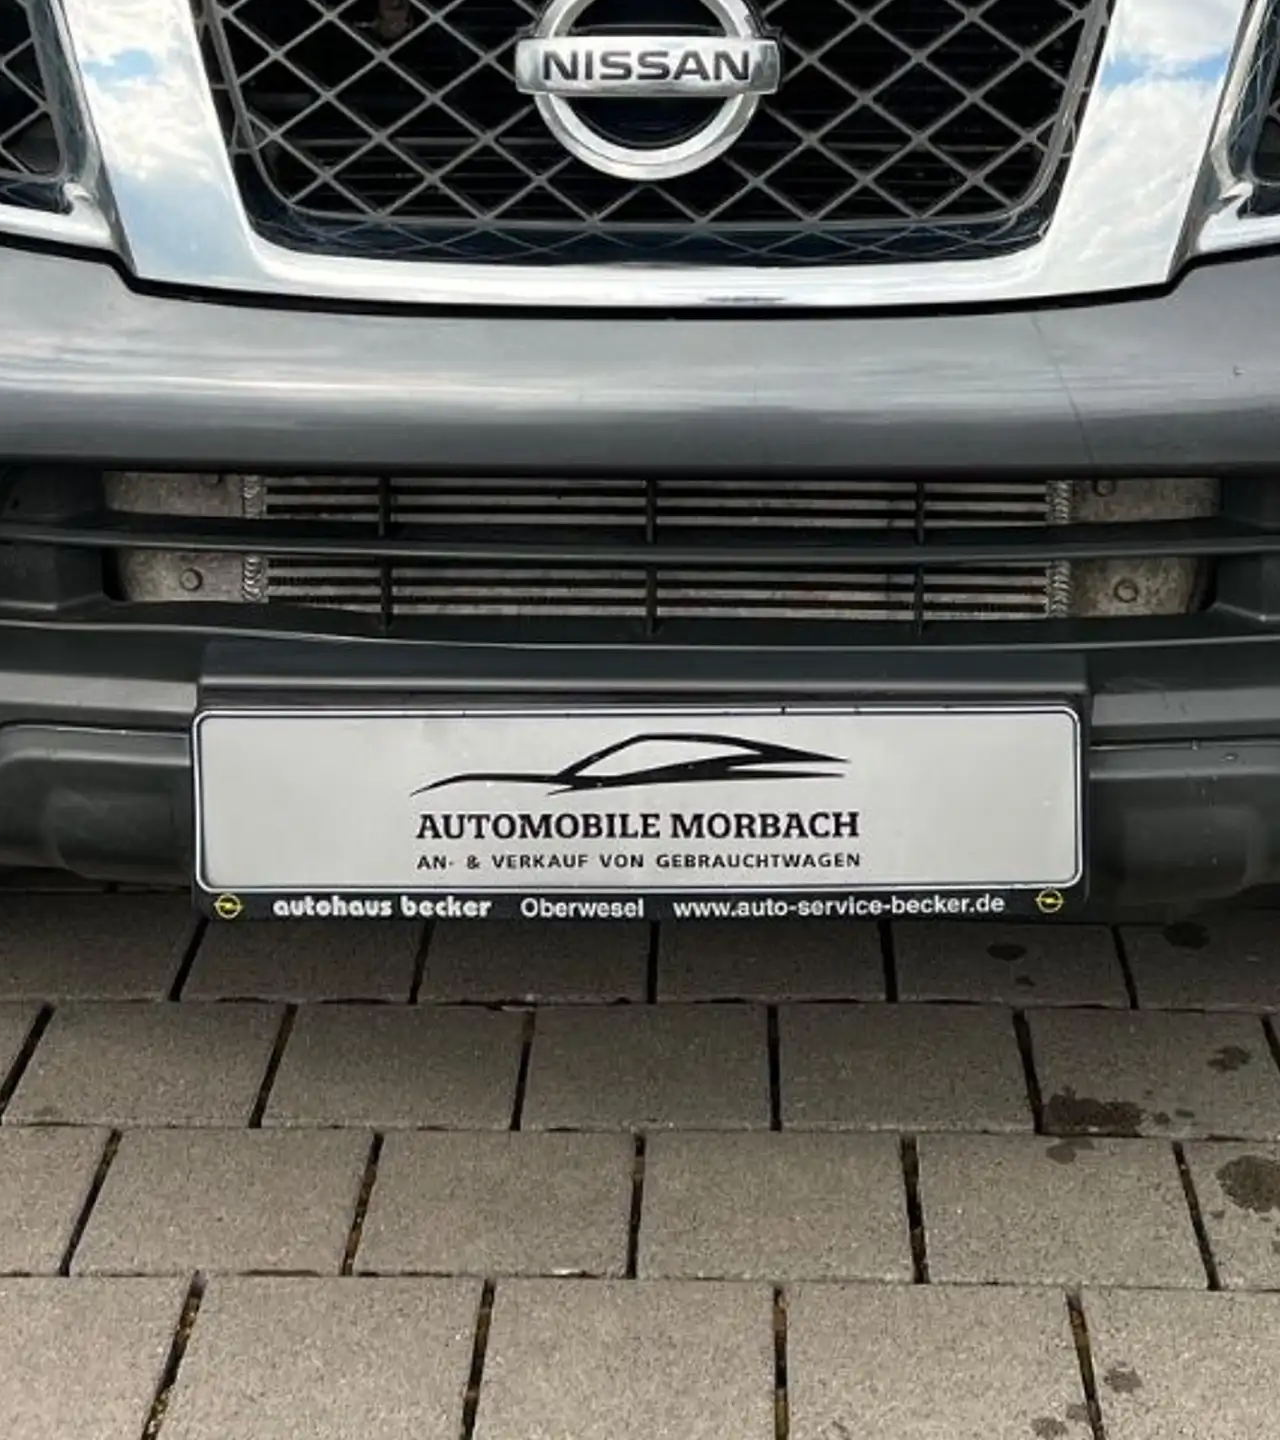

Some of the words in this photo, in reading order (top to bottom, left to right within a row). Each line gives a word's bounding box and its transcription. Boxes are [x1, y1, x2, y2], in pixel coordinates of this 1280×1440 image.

[542, 50, 750, 82] NISSAN
[416, 812, 661, 839] AUTOMOBILE
[669, 811, 860, 839] MORBACH
[416, 854, 454, 870] AN-
[466, 854, 481, 870] &
[491, 853, 589, 869] VERKAUF
[598, 853, 645, 869] VON
[656, 852, 861, 869] GEBRAUCHTWAGEN
[272, 895, 393, 918] autohaus
[400, 895, 493, 918] becker
[519, 897, 645, 918] Oberwesel
[672, 894, 1005, 918] www.auto-service-becker.de
